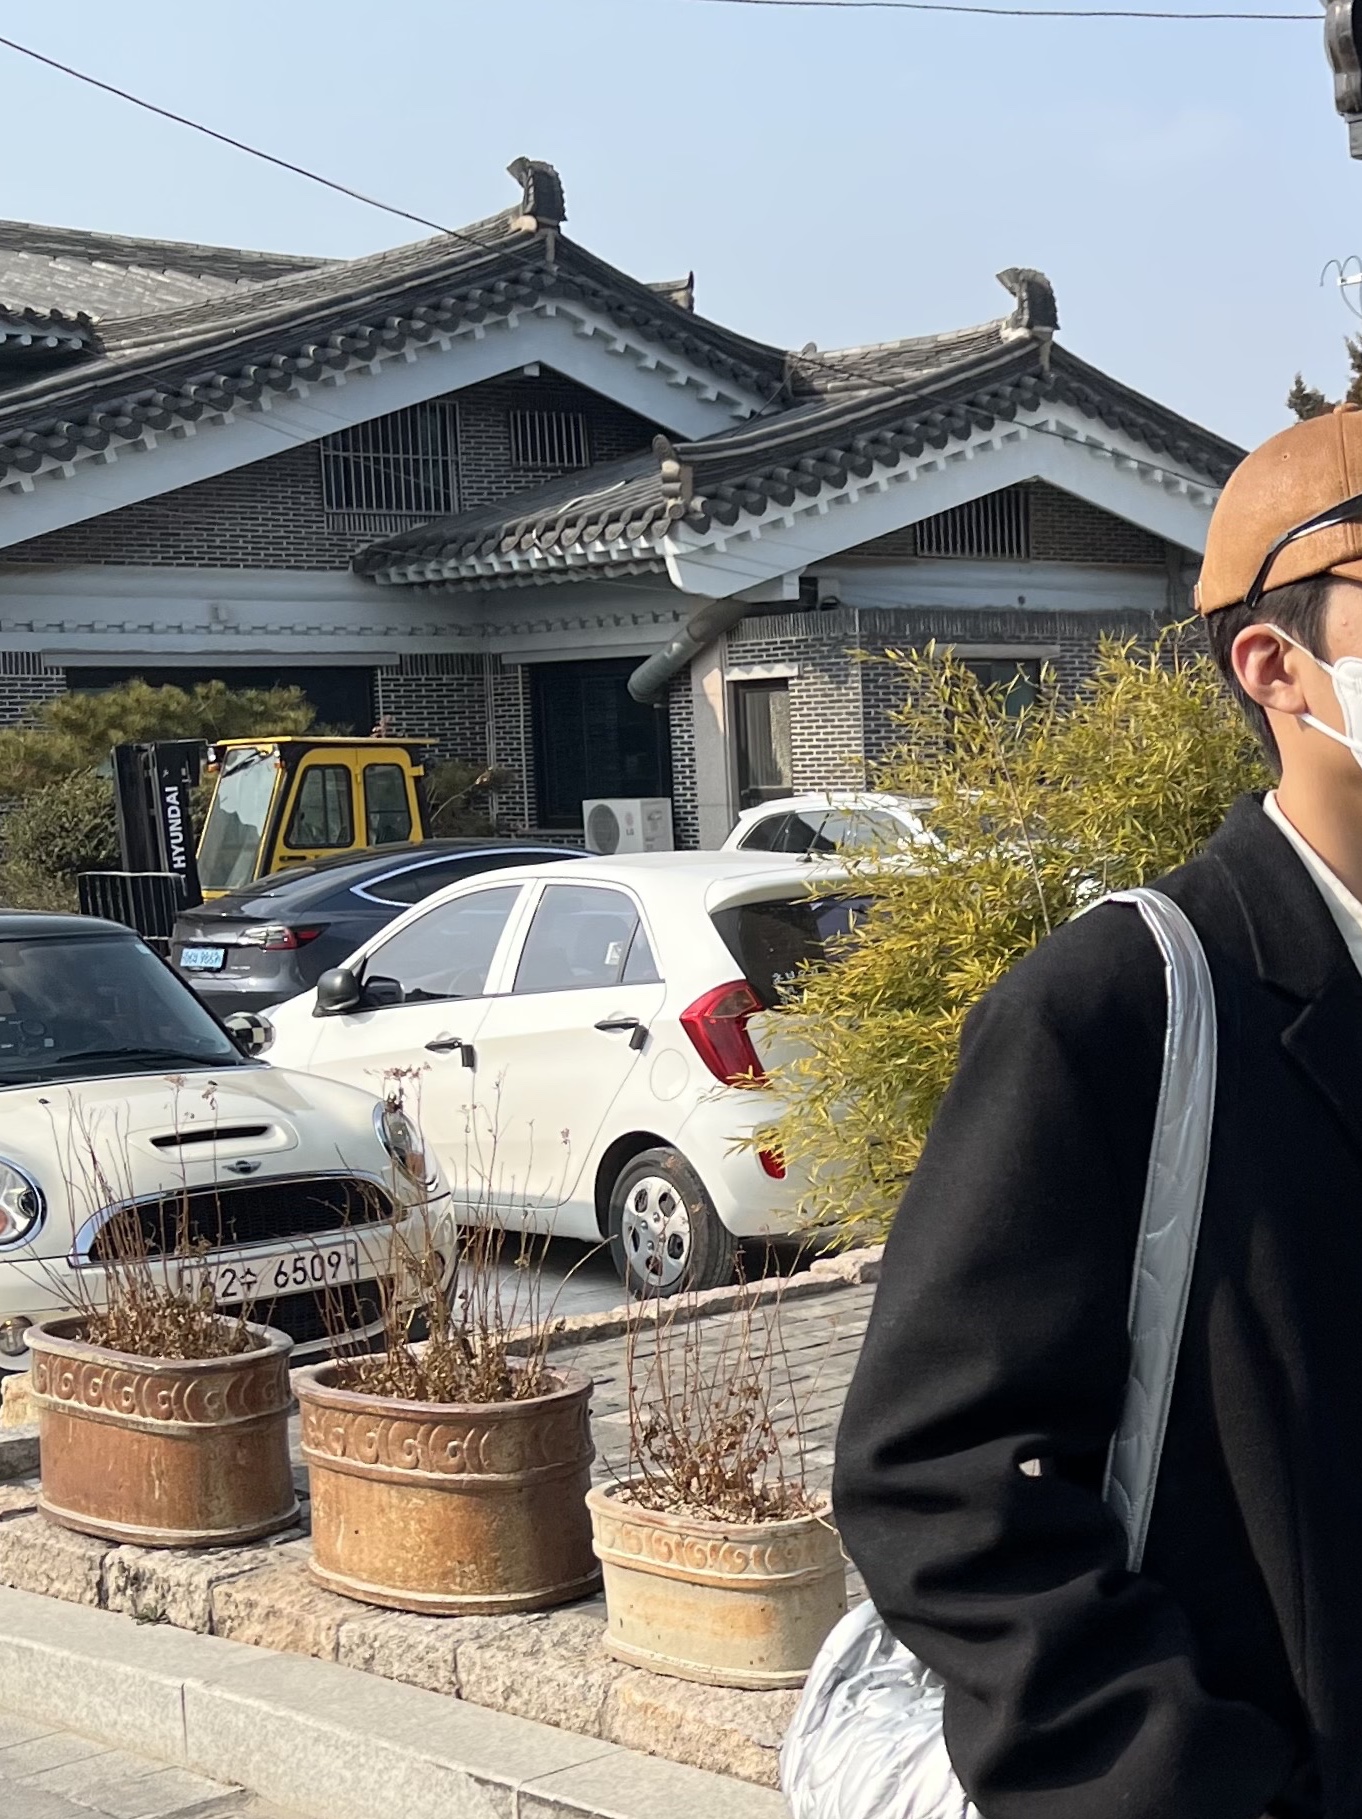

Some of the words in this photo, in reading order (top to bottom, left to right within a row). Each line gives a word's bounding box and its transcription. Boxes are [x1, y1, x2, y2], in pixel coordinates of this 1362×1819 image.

[165, 785, 187, 869] HYUNDAI
[625, 828, 635, 836] LG
[273, 1250, 342, 1289] 6509
